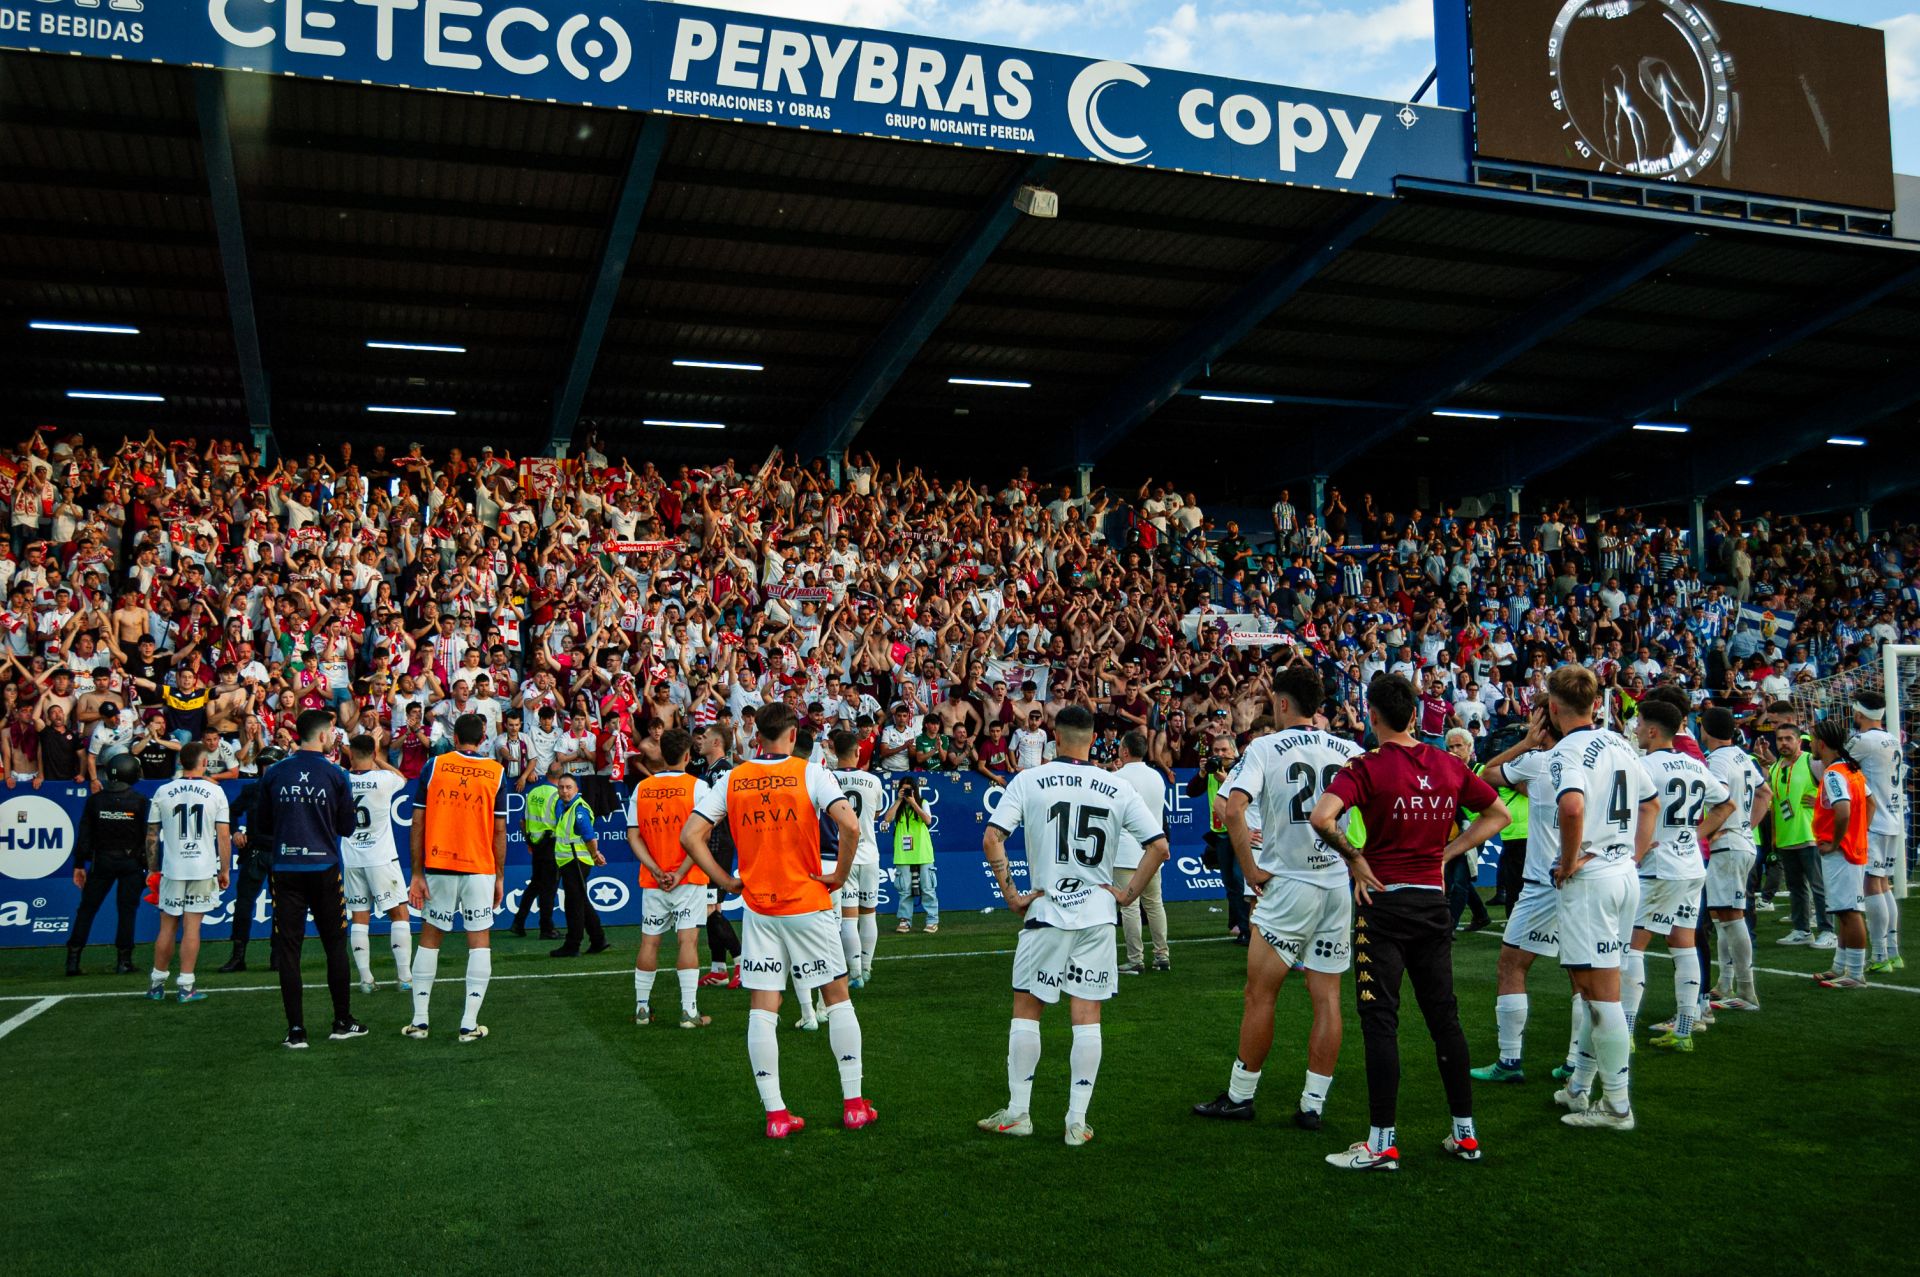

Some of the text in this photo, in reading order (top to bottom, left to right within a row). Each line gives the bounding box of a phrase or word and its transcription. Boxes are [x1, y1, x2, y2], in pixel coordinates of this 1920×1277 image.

[0, 8, 144, 43] DE BEBIDAS
[669, 18, 1034, 120] PERYBRAS
[667, 89, 831, 120] PERFORACIONES Y OBRAS
[885, 113, 1035, 142] GRUPO MORANTE PEREDA
[1178, 88, 1382, 180] copy
[1234, 632, 1284, 640] CULTURAL
[1274, 733, 1351, 758] ADRIAN RUIZ
[441, 763, 495, 780] Kappa
[167, 784, 212, 799] SAMANES
[280, 785, 327, 798] ARVA
[733, 776, 798, 791] Kappa
[1037, 775, 1118, 799] VICTOR RUIZ
[641, 787, 686, 799] Kappa
[1394, 796, 1454, 809] ARVA
[1607, 769, 1631, 834] 4
[1663, 777, 1706, 828] 22
[173, 803, 205, 840] 11
[742, 808, 798, 827] ARVA
[1392, 812, 1453, 820] HOTELES
[1046, 800, 1110, 868] 15
[1186, 877, 1225, 889] LÍDER
[473, 907, 492, 919] CJR
[33, 920, 70, 930] Roca
[743, 957, 782, 973] RIAÑO
[802, 959, 828, 975] CJR
[1084, 970, 1109, 984] CJR
